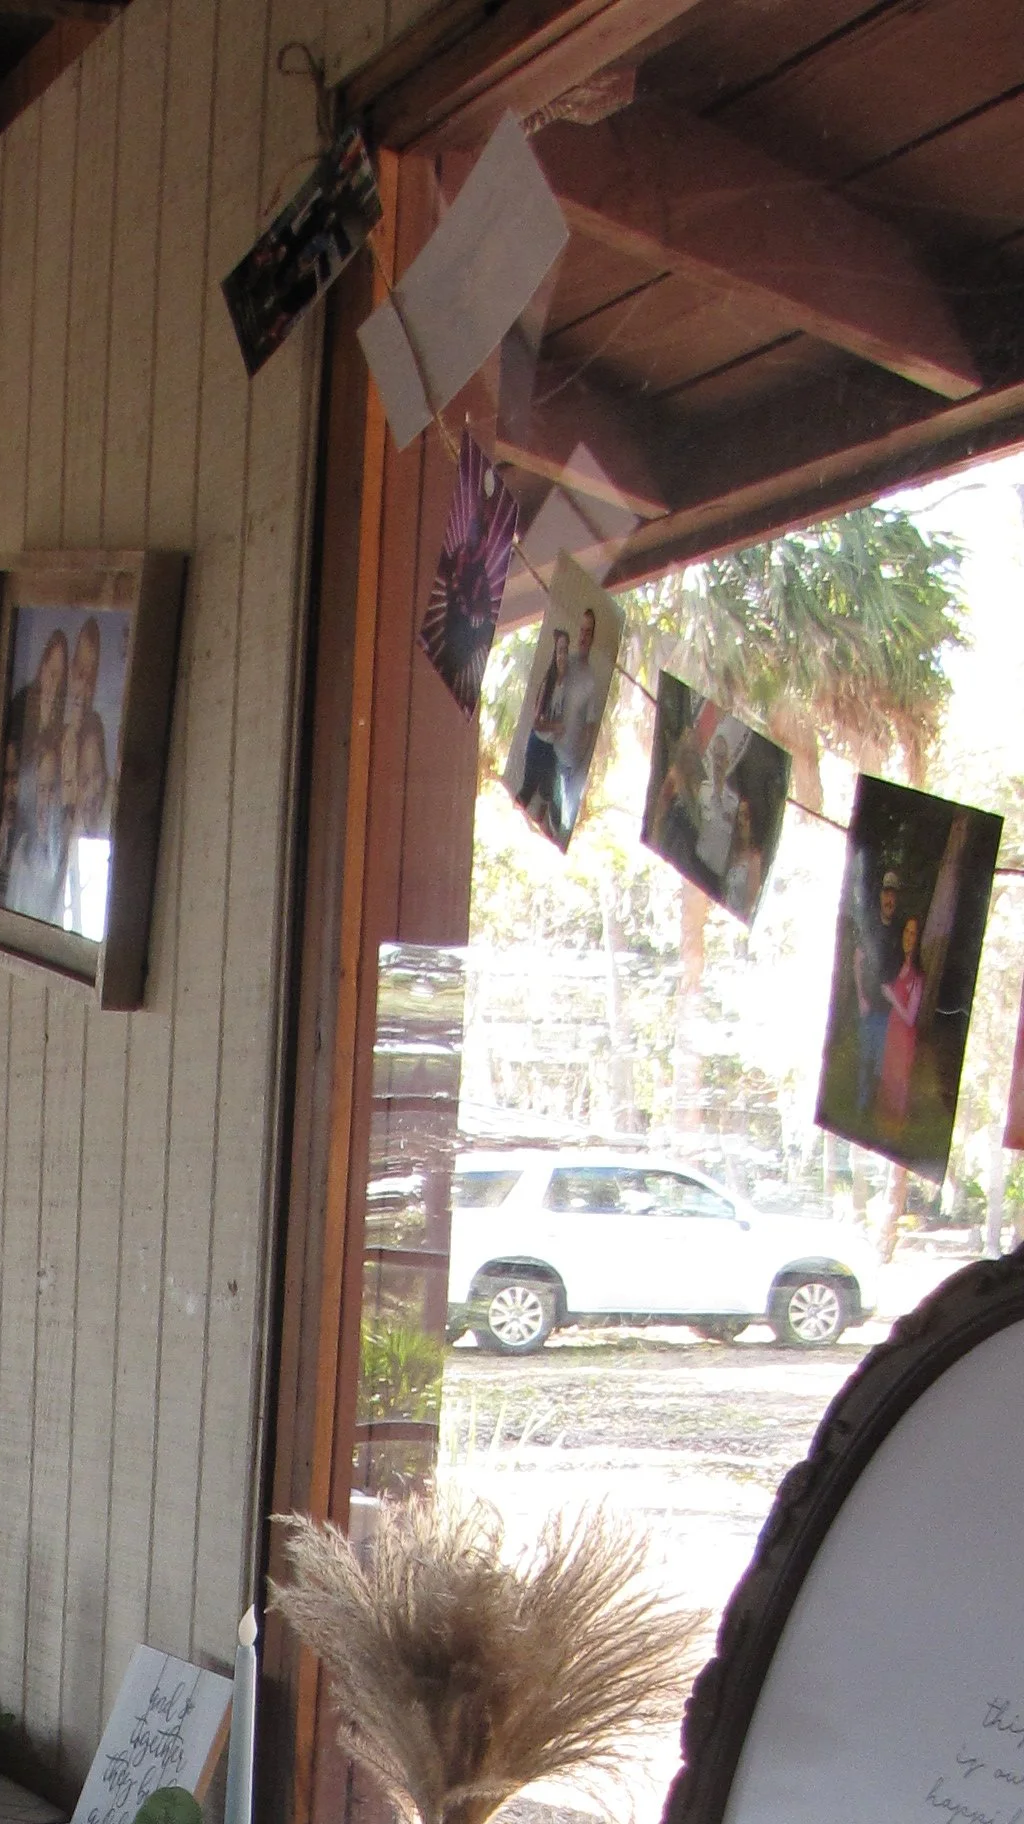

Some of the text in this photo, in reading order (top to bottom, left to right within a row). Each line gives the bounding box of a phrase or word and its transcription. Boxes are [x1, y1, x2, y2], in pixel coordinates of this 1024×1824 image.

[148, 1681, 185, 1723] and
[128, 1713, 189, 1773] together
[102, 1753, 138, 1808] they
[994, 1767, 1024, 1784] ou
